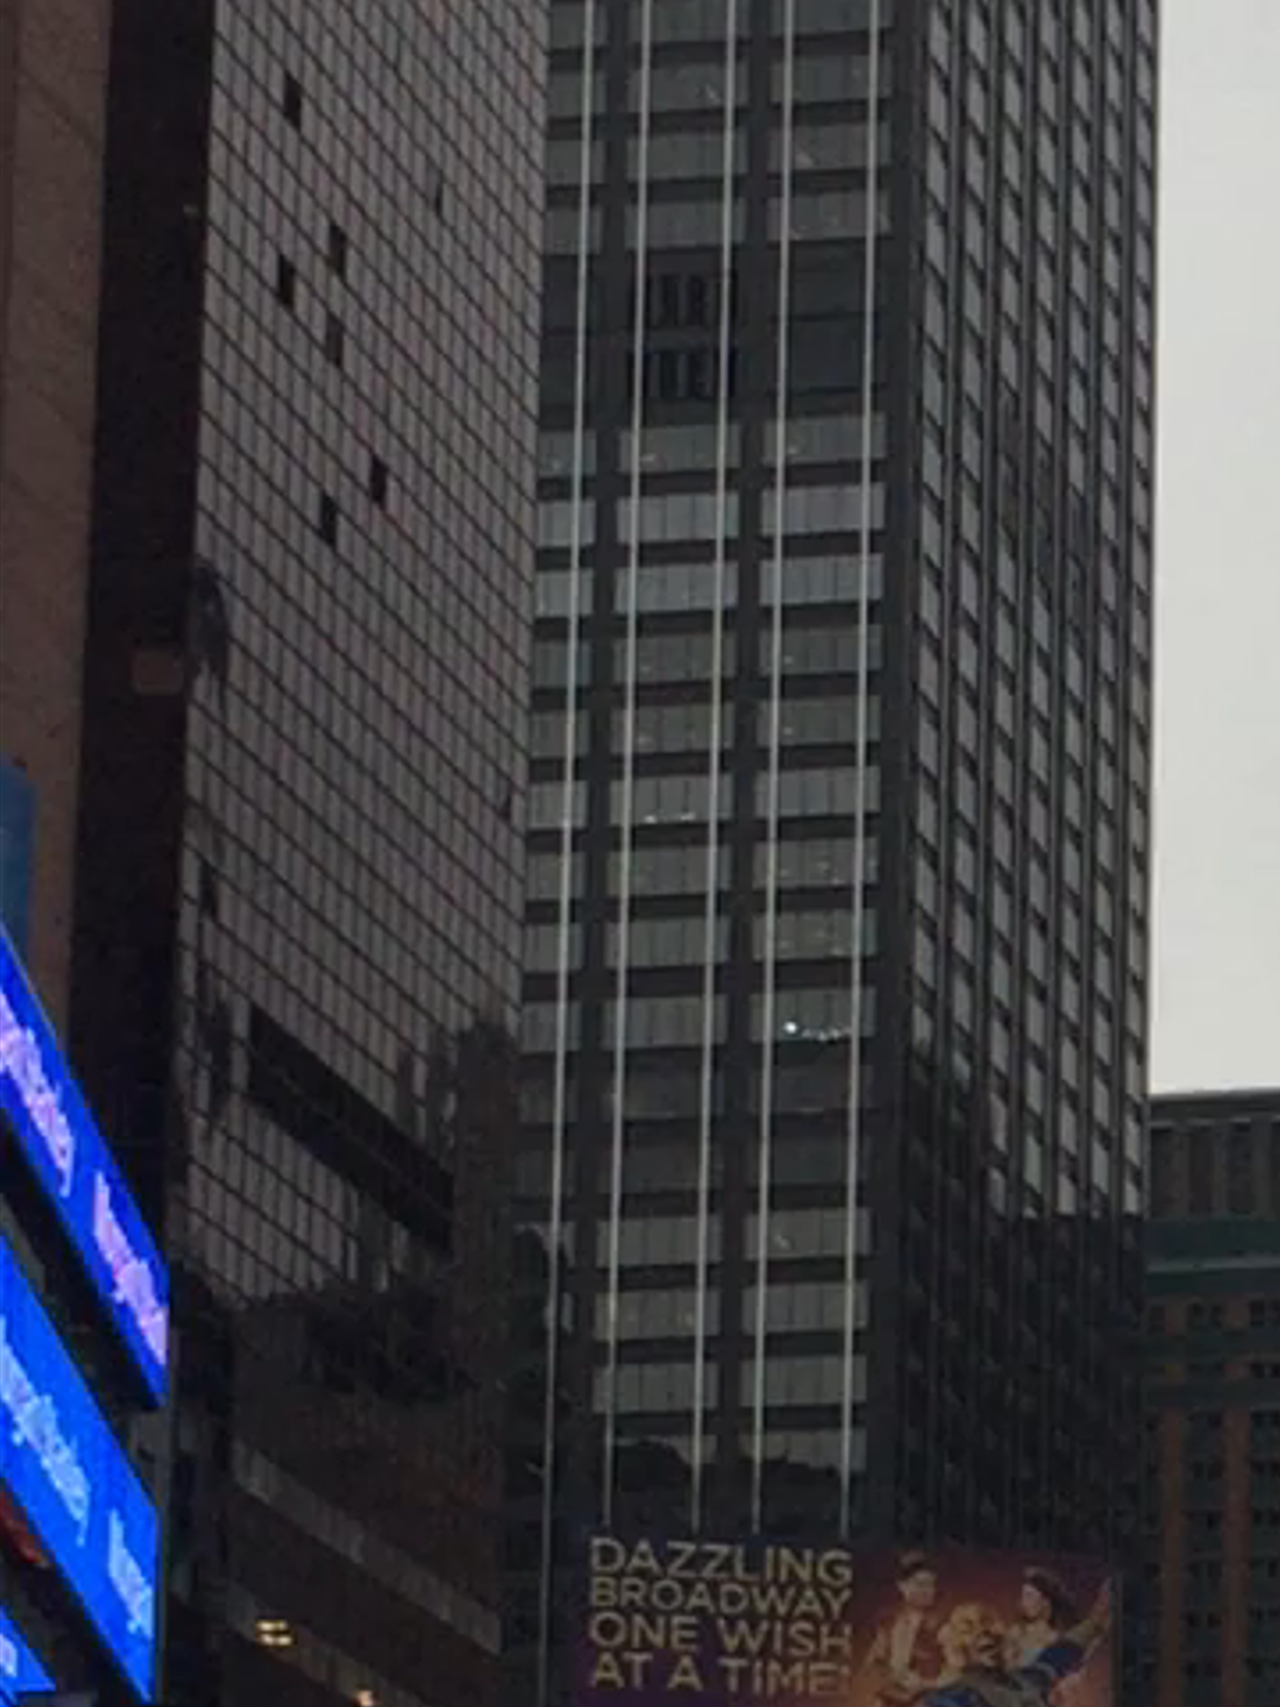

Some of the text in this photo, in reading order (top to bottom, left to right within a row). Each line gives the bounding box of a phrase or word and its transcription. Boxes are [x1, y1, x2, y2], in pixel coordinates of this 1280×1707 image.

[588, 1536, 853, 1587] DAZZLING
[588, 1575, 853, 1621] BROADWAY
[588, 1611, 852, 1657] ONE WISH
[591, 1650, 654, 1692] AT
[667, 1654, 705, 1693] A
